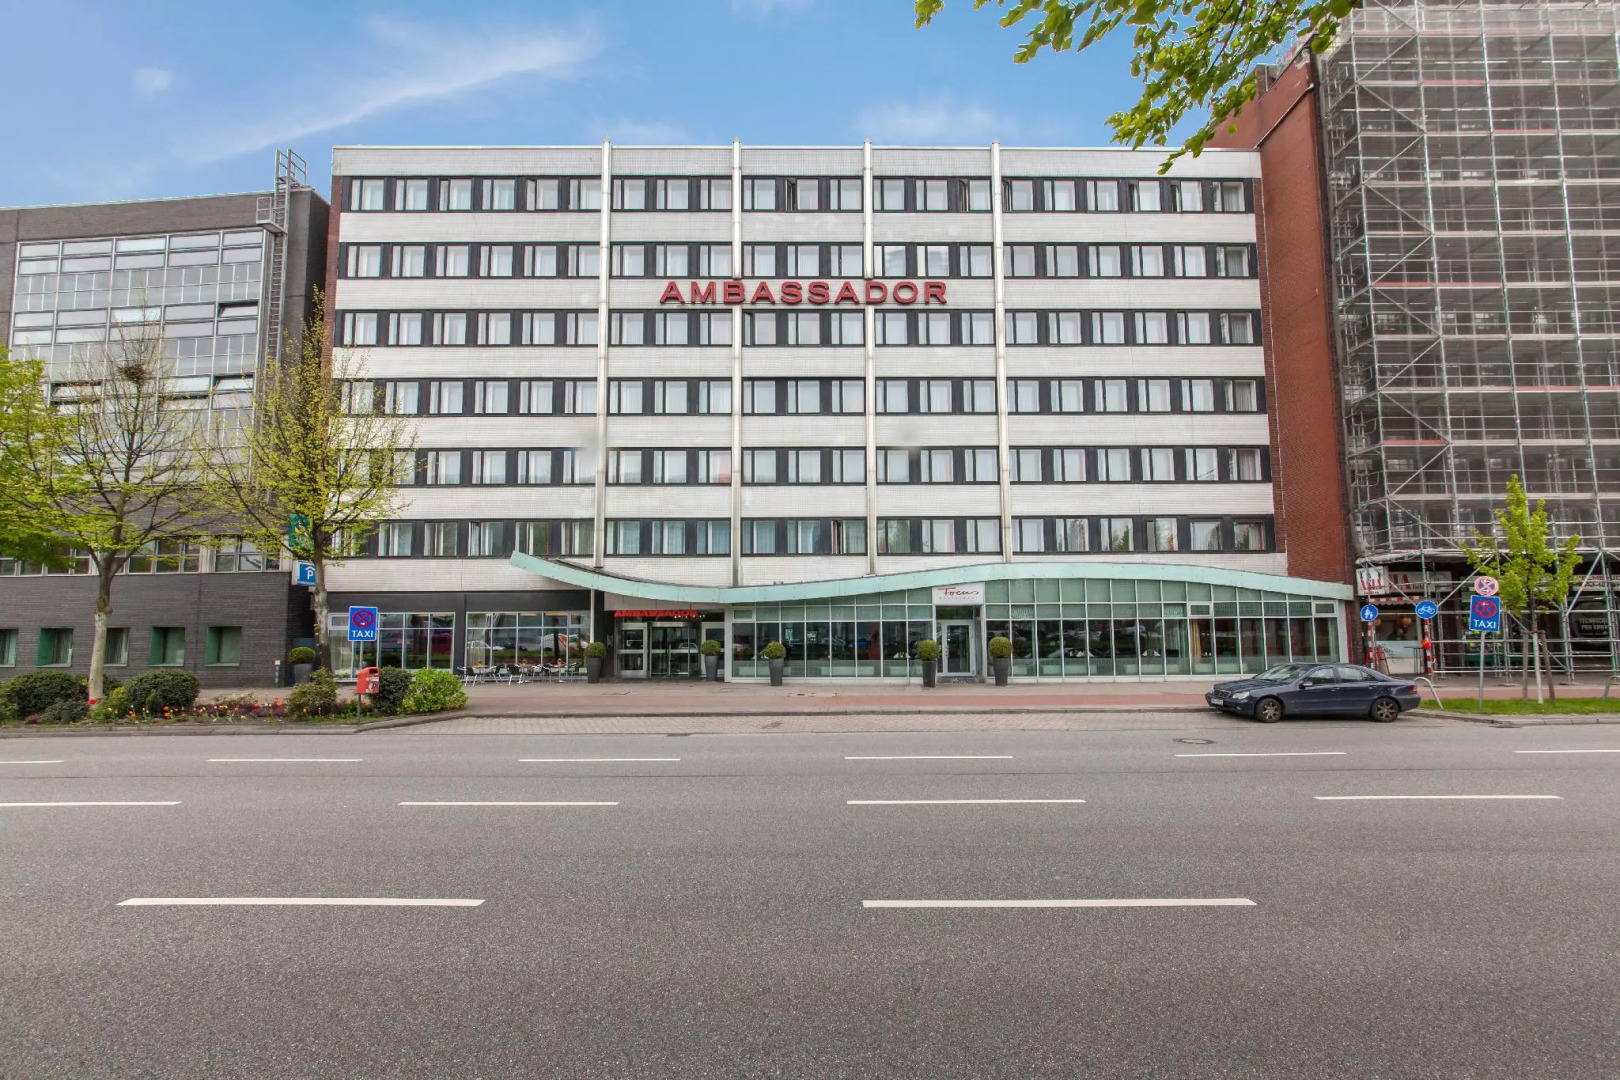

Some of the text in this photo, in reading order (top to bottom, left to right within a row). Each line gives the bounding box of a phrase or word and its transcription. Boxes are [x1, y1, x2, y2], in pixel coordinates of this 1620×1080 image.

[660, 281, 948, 304] AMBASSADOR
[307, 570, 314, 580] P
[1473, 619, 1497, 629] TAXI
[351, 630, 374, 638] TAXI
